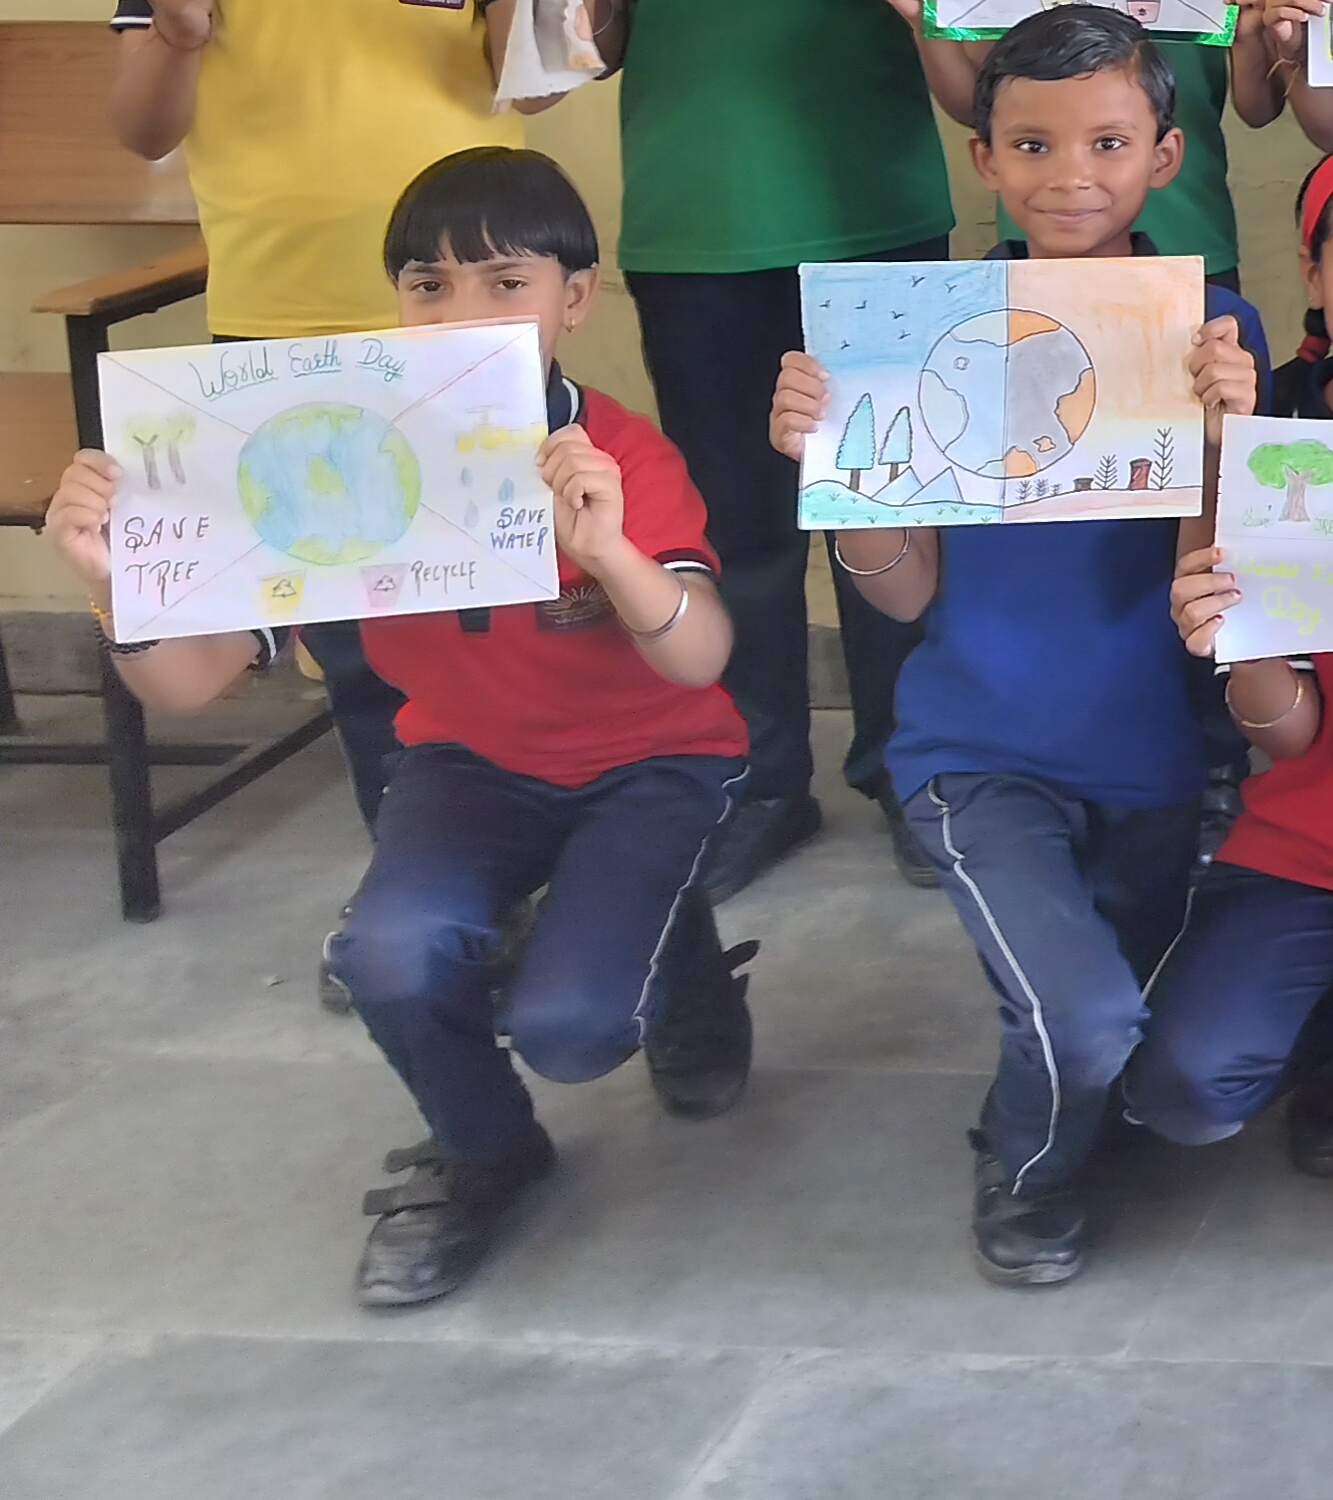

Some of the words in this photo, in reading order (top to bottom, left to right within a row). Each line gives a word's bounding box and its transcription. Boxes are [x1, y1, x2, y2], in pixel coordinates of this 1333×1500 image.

[187, 344, 277, 400] World
[288, 338, 342, 377] Earth
[356, 337, 405, 383] Day
[123, 515, 210, 551] SAVE
[496, 506, 545, 529] SAVE
[489, 526, 550, 555] WATER
[125, 559, 200, 606] TREE
[410, 559, 477, 595] RECYCLE
